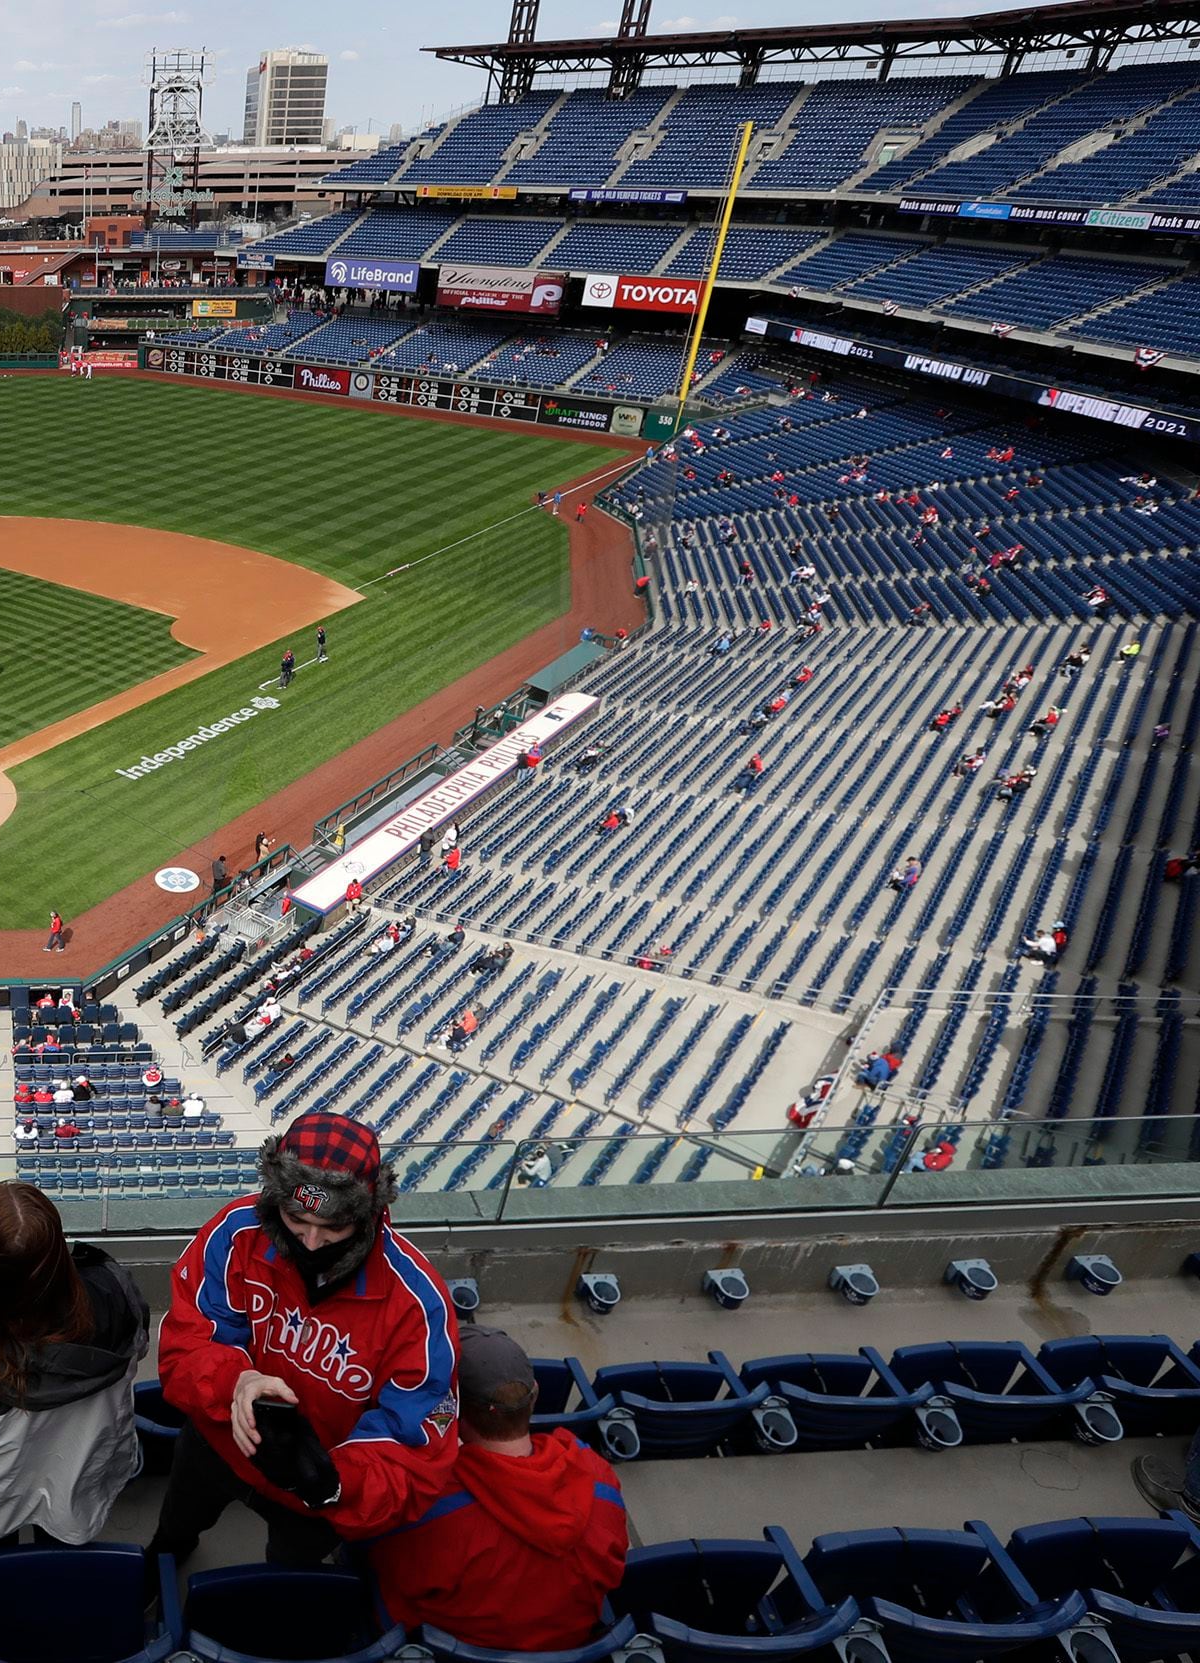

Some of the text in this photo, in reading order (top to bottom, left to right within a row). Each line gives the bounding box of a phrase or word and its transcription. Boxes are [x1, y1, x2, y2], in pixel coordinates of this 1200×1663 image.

[160, 205, 186, 216] Park
[1100, 211, 1145, 228] Citizens
[1152, 215, 1183, 228] Masks
[351, 266, 413, 284] LifeBrand
[441, 270, 532, 290] Yuengling
[621, 284, 697, 306] TOYOTA
[850, 346, 874, 359] 2021
[301, 368, 341, 391] Phillies
[545, 407, 608, 421] DRAFTKINGS
[558, 416, 606, 429] SPORTSBOOK
[1055, 392, 1186, 436] OPENING DAY 2021
[115, 707, 259, 781] Independence
[384, 731, 541, 841] PHILADELPHIA PHILLIES
